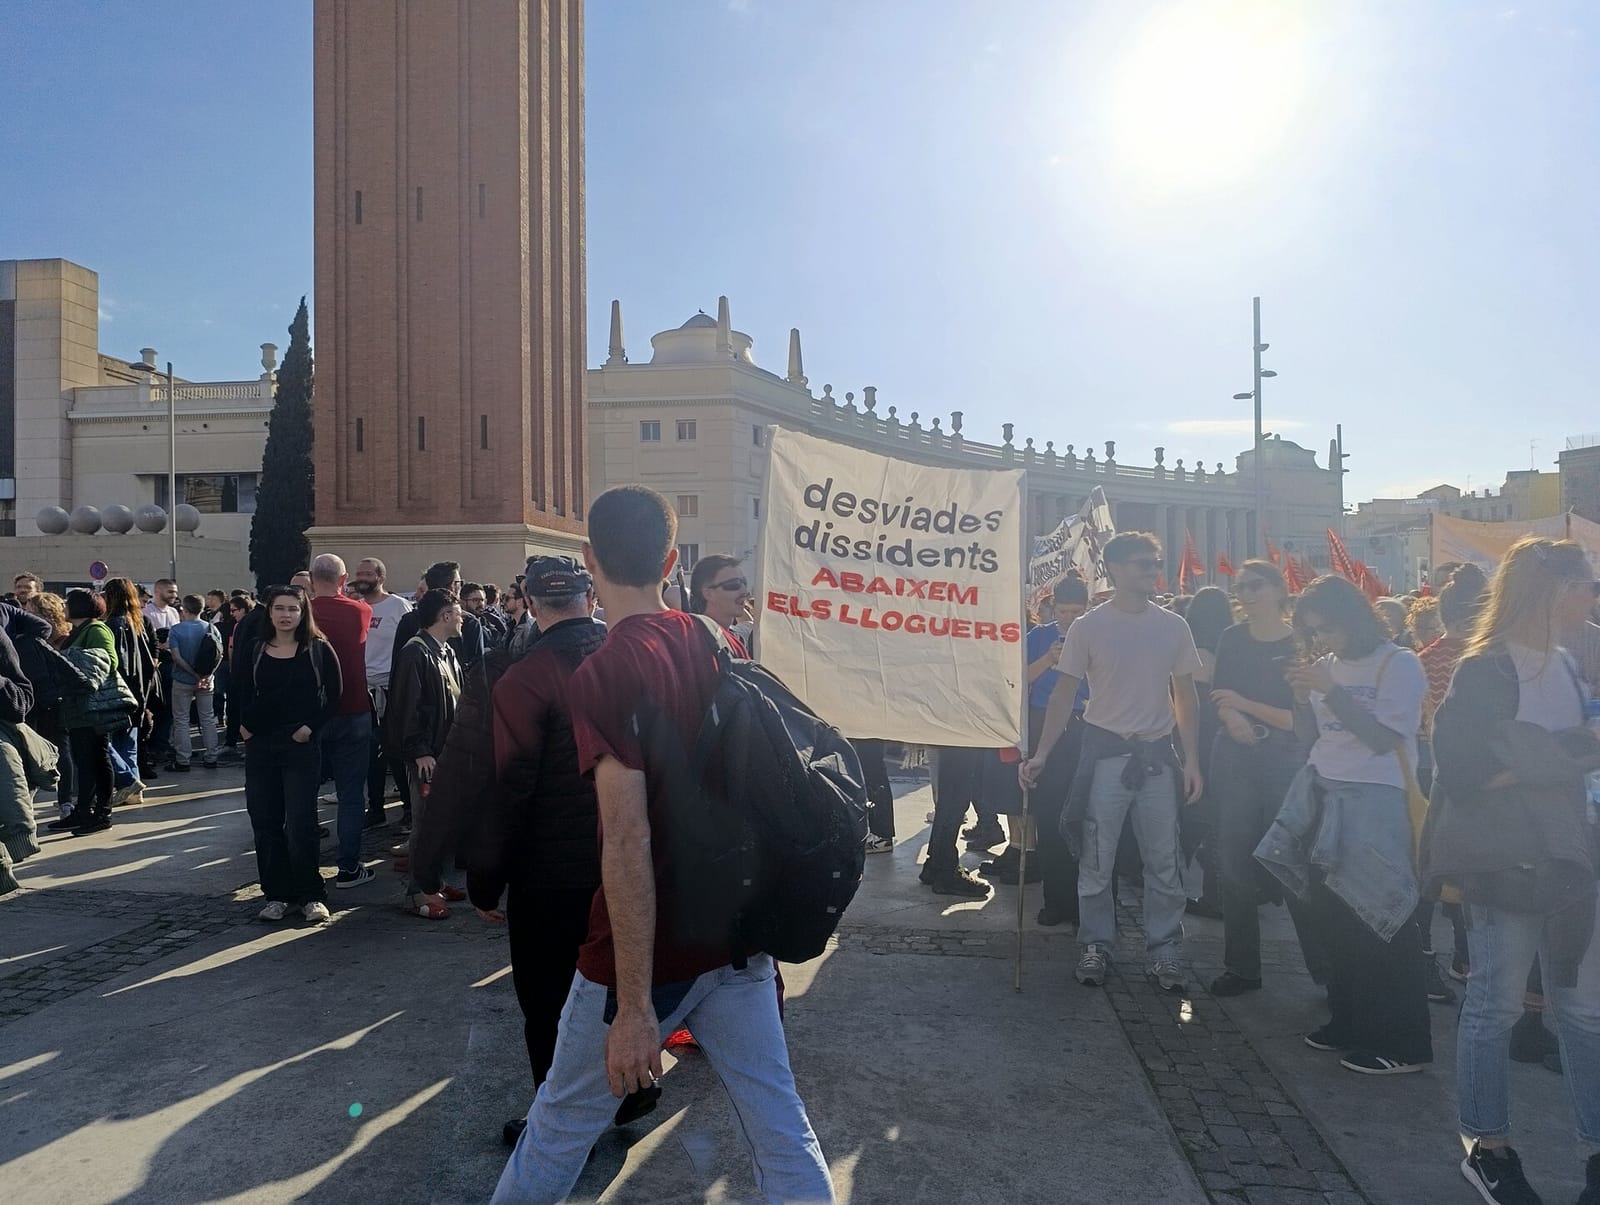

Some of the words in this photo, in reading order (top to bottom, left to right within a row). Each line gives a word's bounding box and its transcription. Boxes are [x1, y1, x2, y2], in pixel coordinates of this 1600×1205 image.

[794, 520, 999, 573] dissidents
[811, 567, 978, 606] ABAIXEM
[767, 591, 833, 620] ELS
[839, 604, 1020, 643] LLOGUERS
